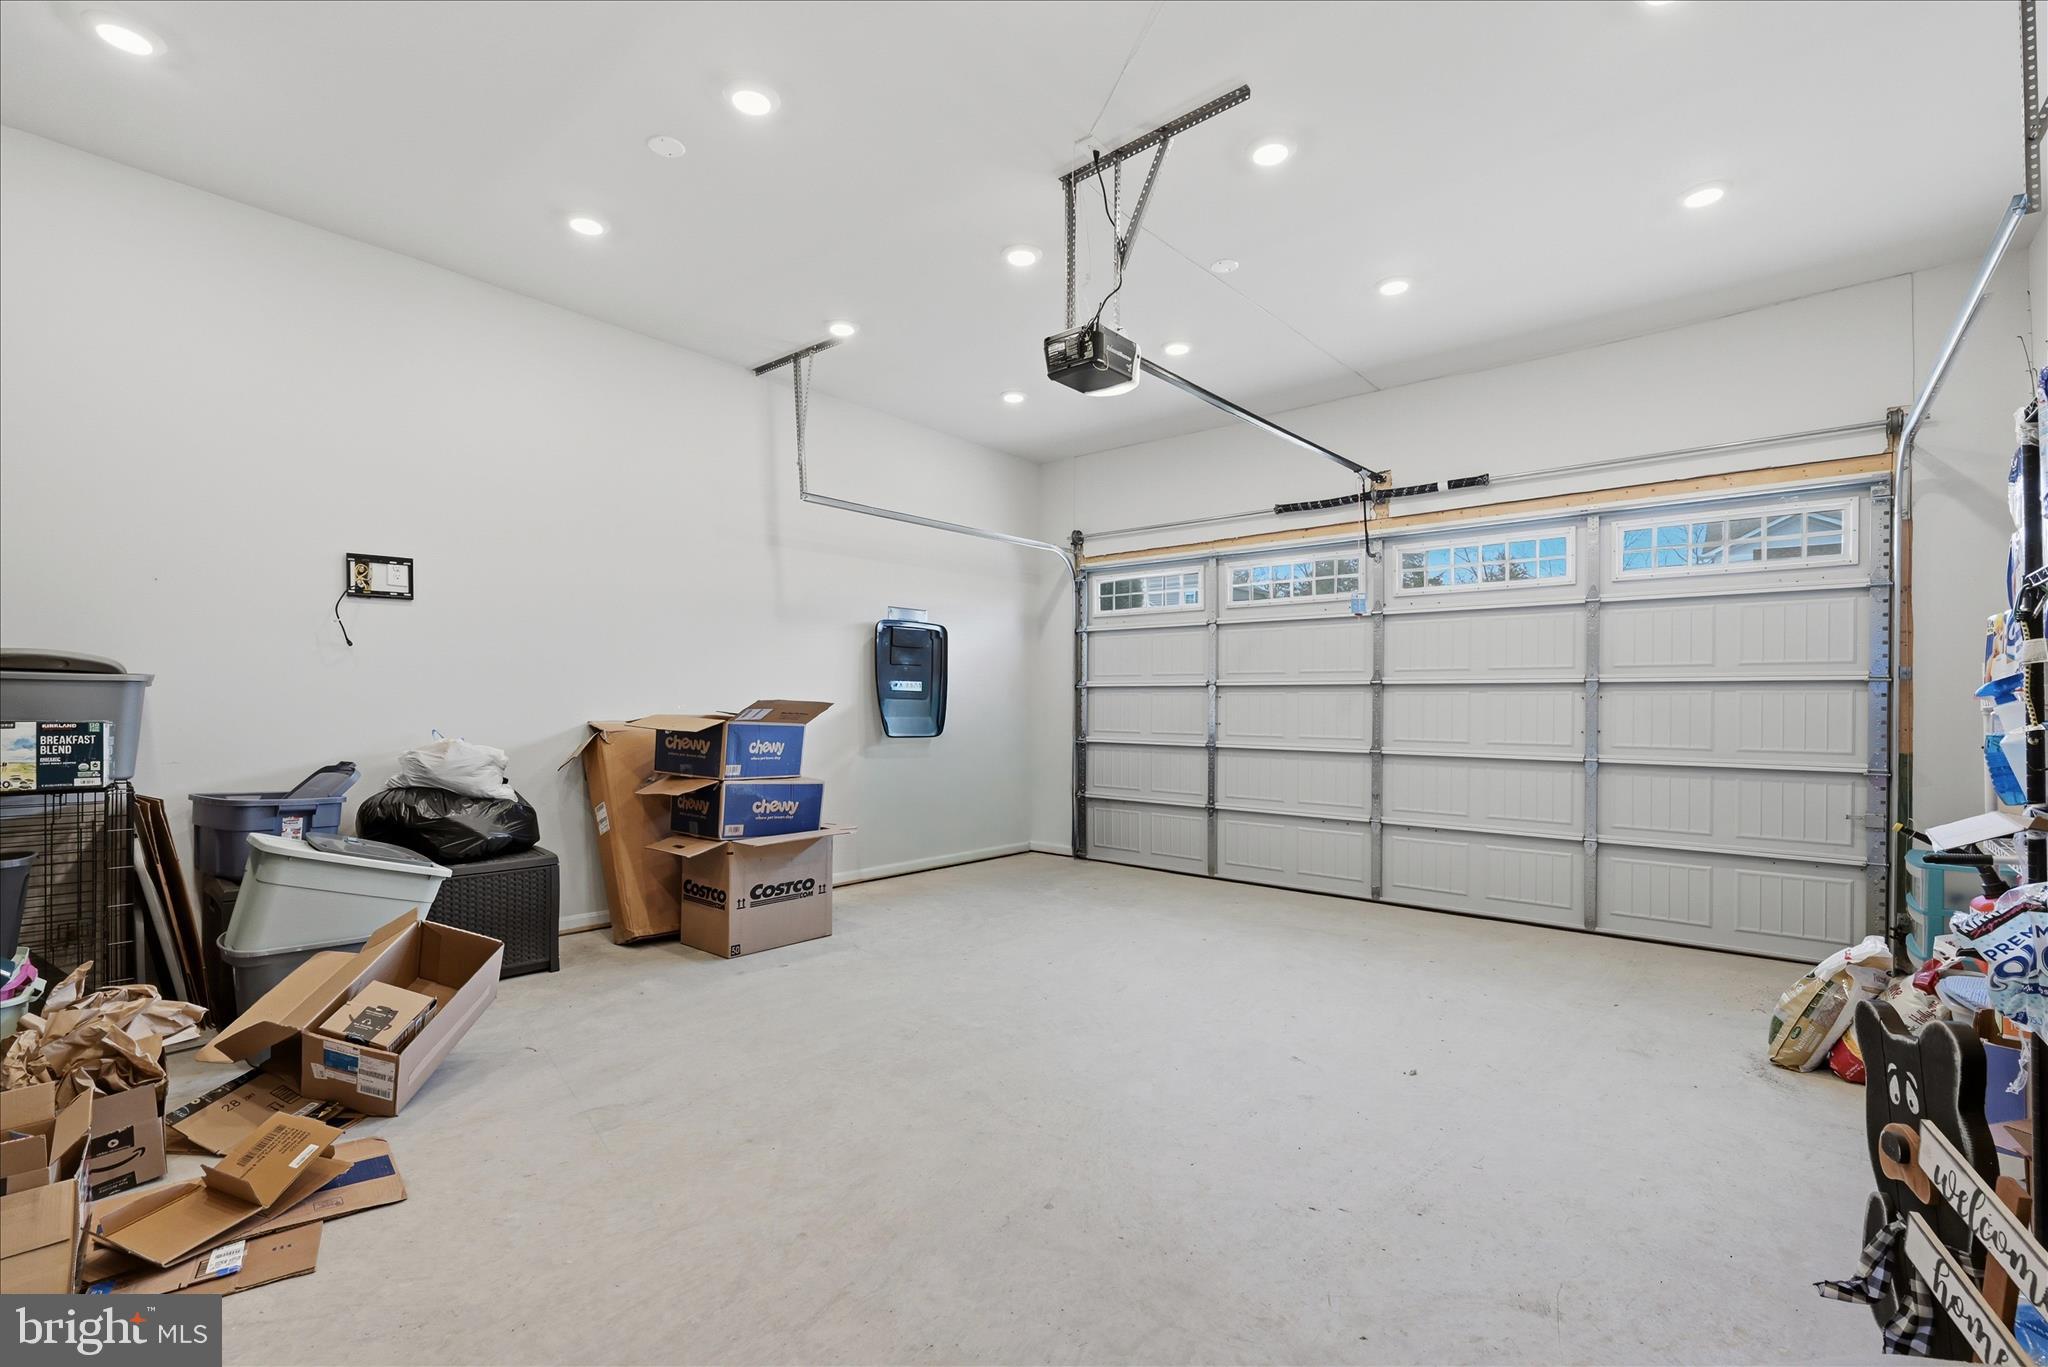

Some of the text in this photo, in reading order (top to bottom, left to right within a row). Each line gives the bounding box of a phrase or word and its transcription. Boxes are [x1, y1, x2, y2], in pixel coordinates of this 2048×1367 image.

[40, 735, 96, 744] BREAKFAST
[665, 735, 710, 754] chewy
[748, 740, 785, 755] chewy
[40, 745, 72, 754] BLEND
[677, 796, 710, 815] chewy
[752, 799, 799, 815] chewy
[683, 879, 727, 903] COSTCO
[749, 878, 815, 900] COSTCO
[731, 945, 740, 956] 50
[221, 1099, 241, 1113] 28
[1933, 1164, 2048, 1309] welcom
